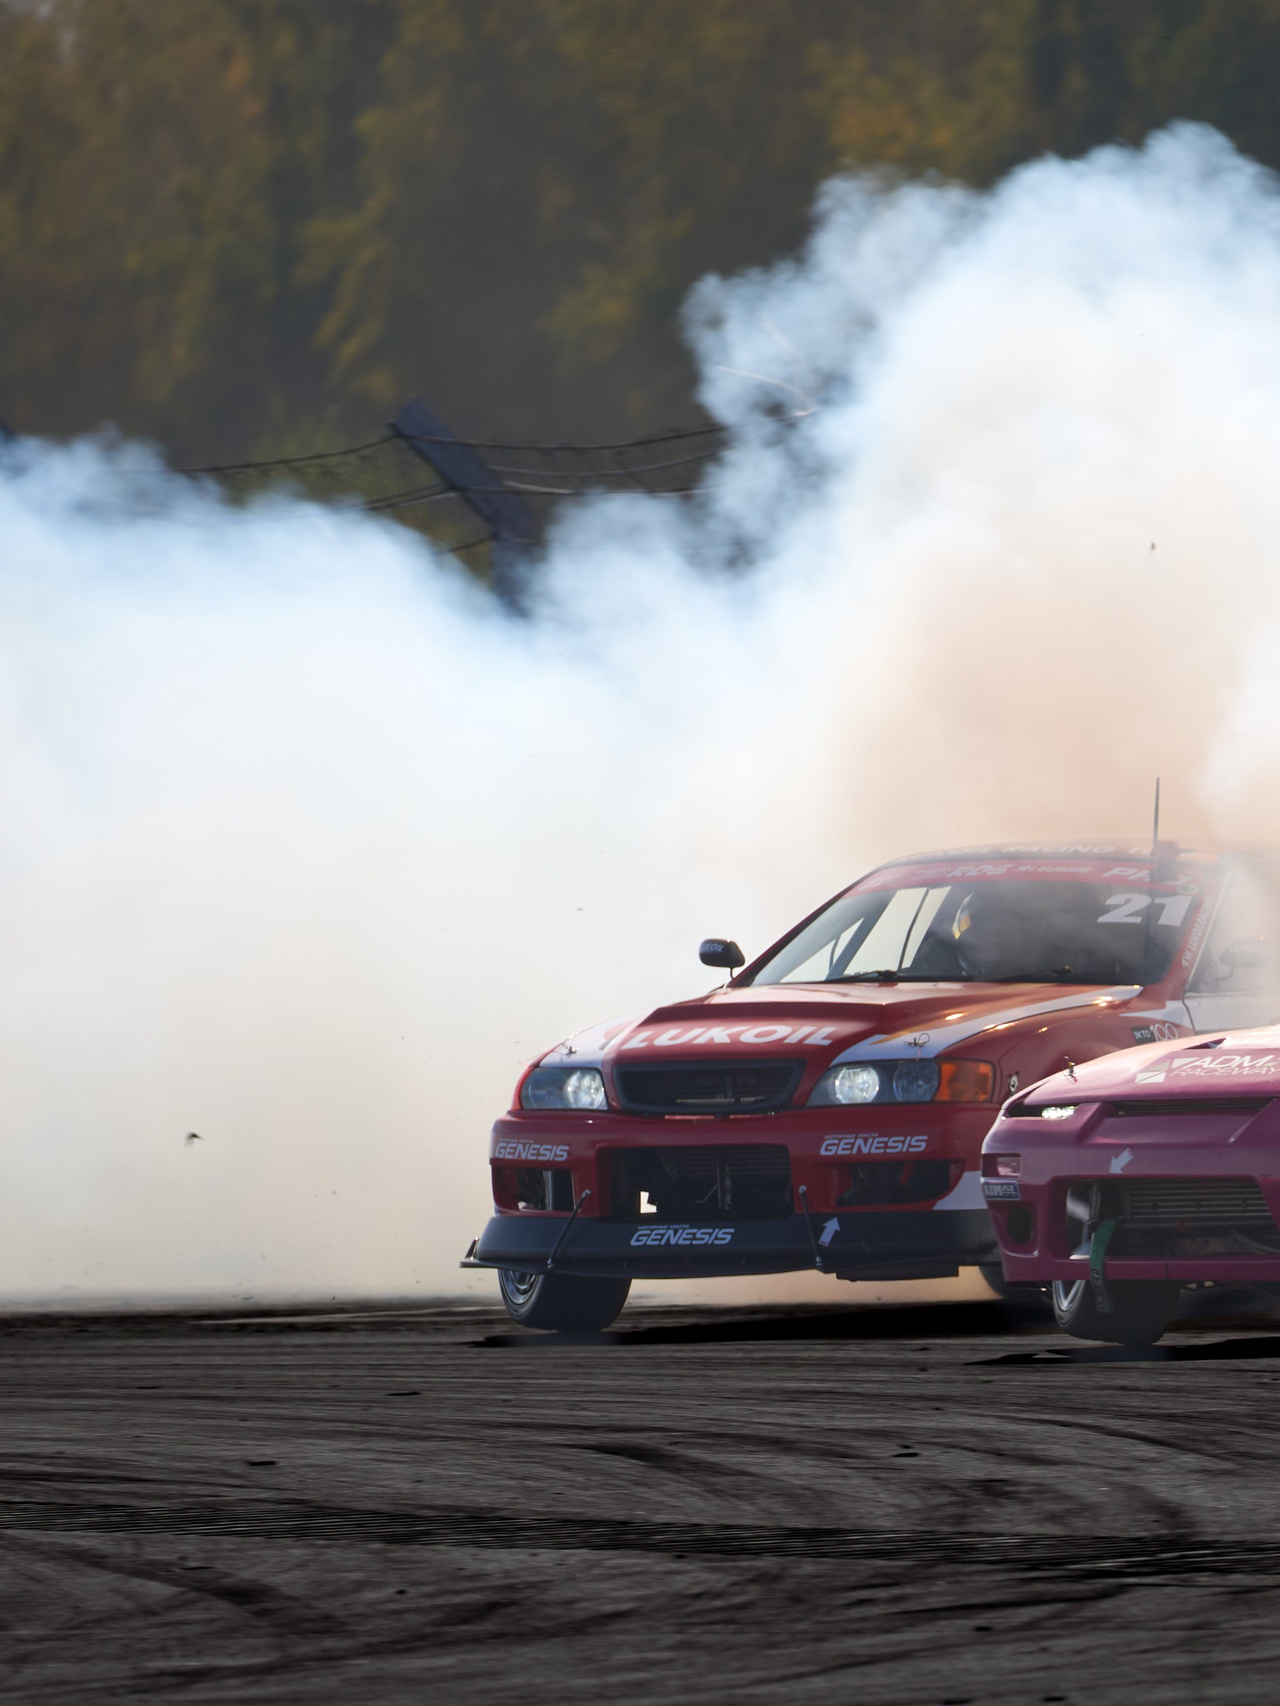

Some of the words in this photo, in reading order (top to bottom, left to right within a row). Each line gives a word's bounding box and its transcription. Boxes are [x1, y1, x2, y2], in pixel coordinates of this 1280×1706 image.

[1097, 893, 1193, 927] 21
[620, 1025, 838, 1050] LUKOIL
[1149, 1022, 1179, 1042] 100
[1184, 1055, 1276, 1069] ADM
[495, 1142, 569, 1162] GENESIS
[820, 1135, 929, 1156] GENESIS
[630, 1228, 735, 1246] GENESIS
